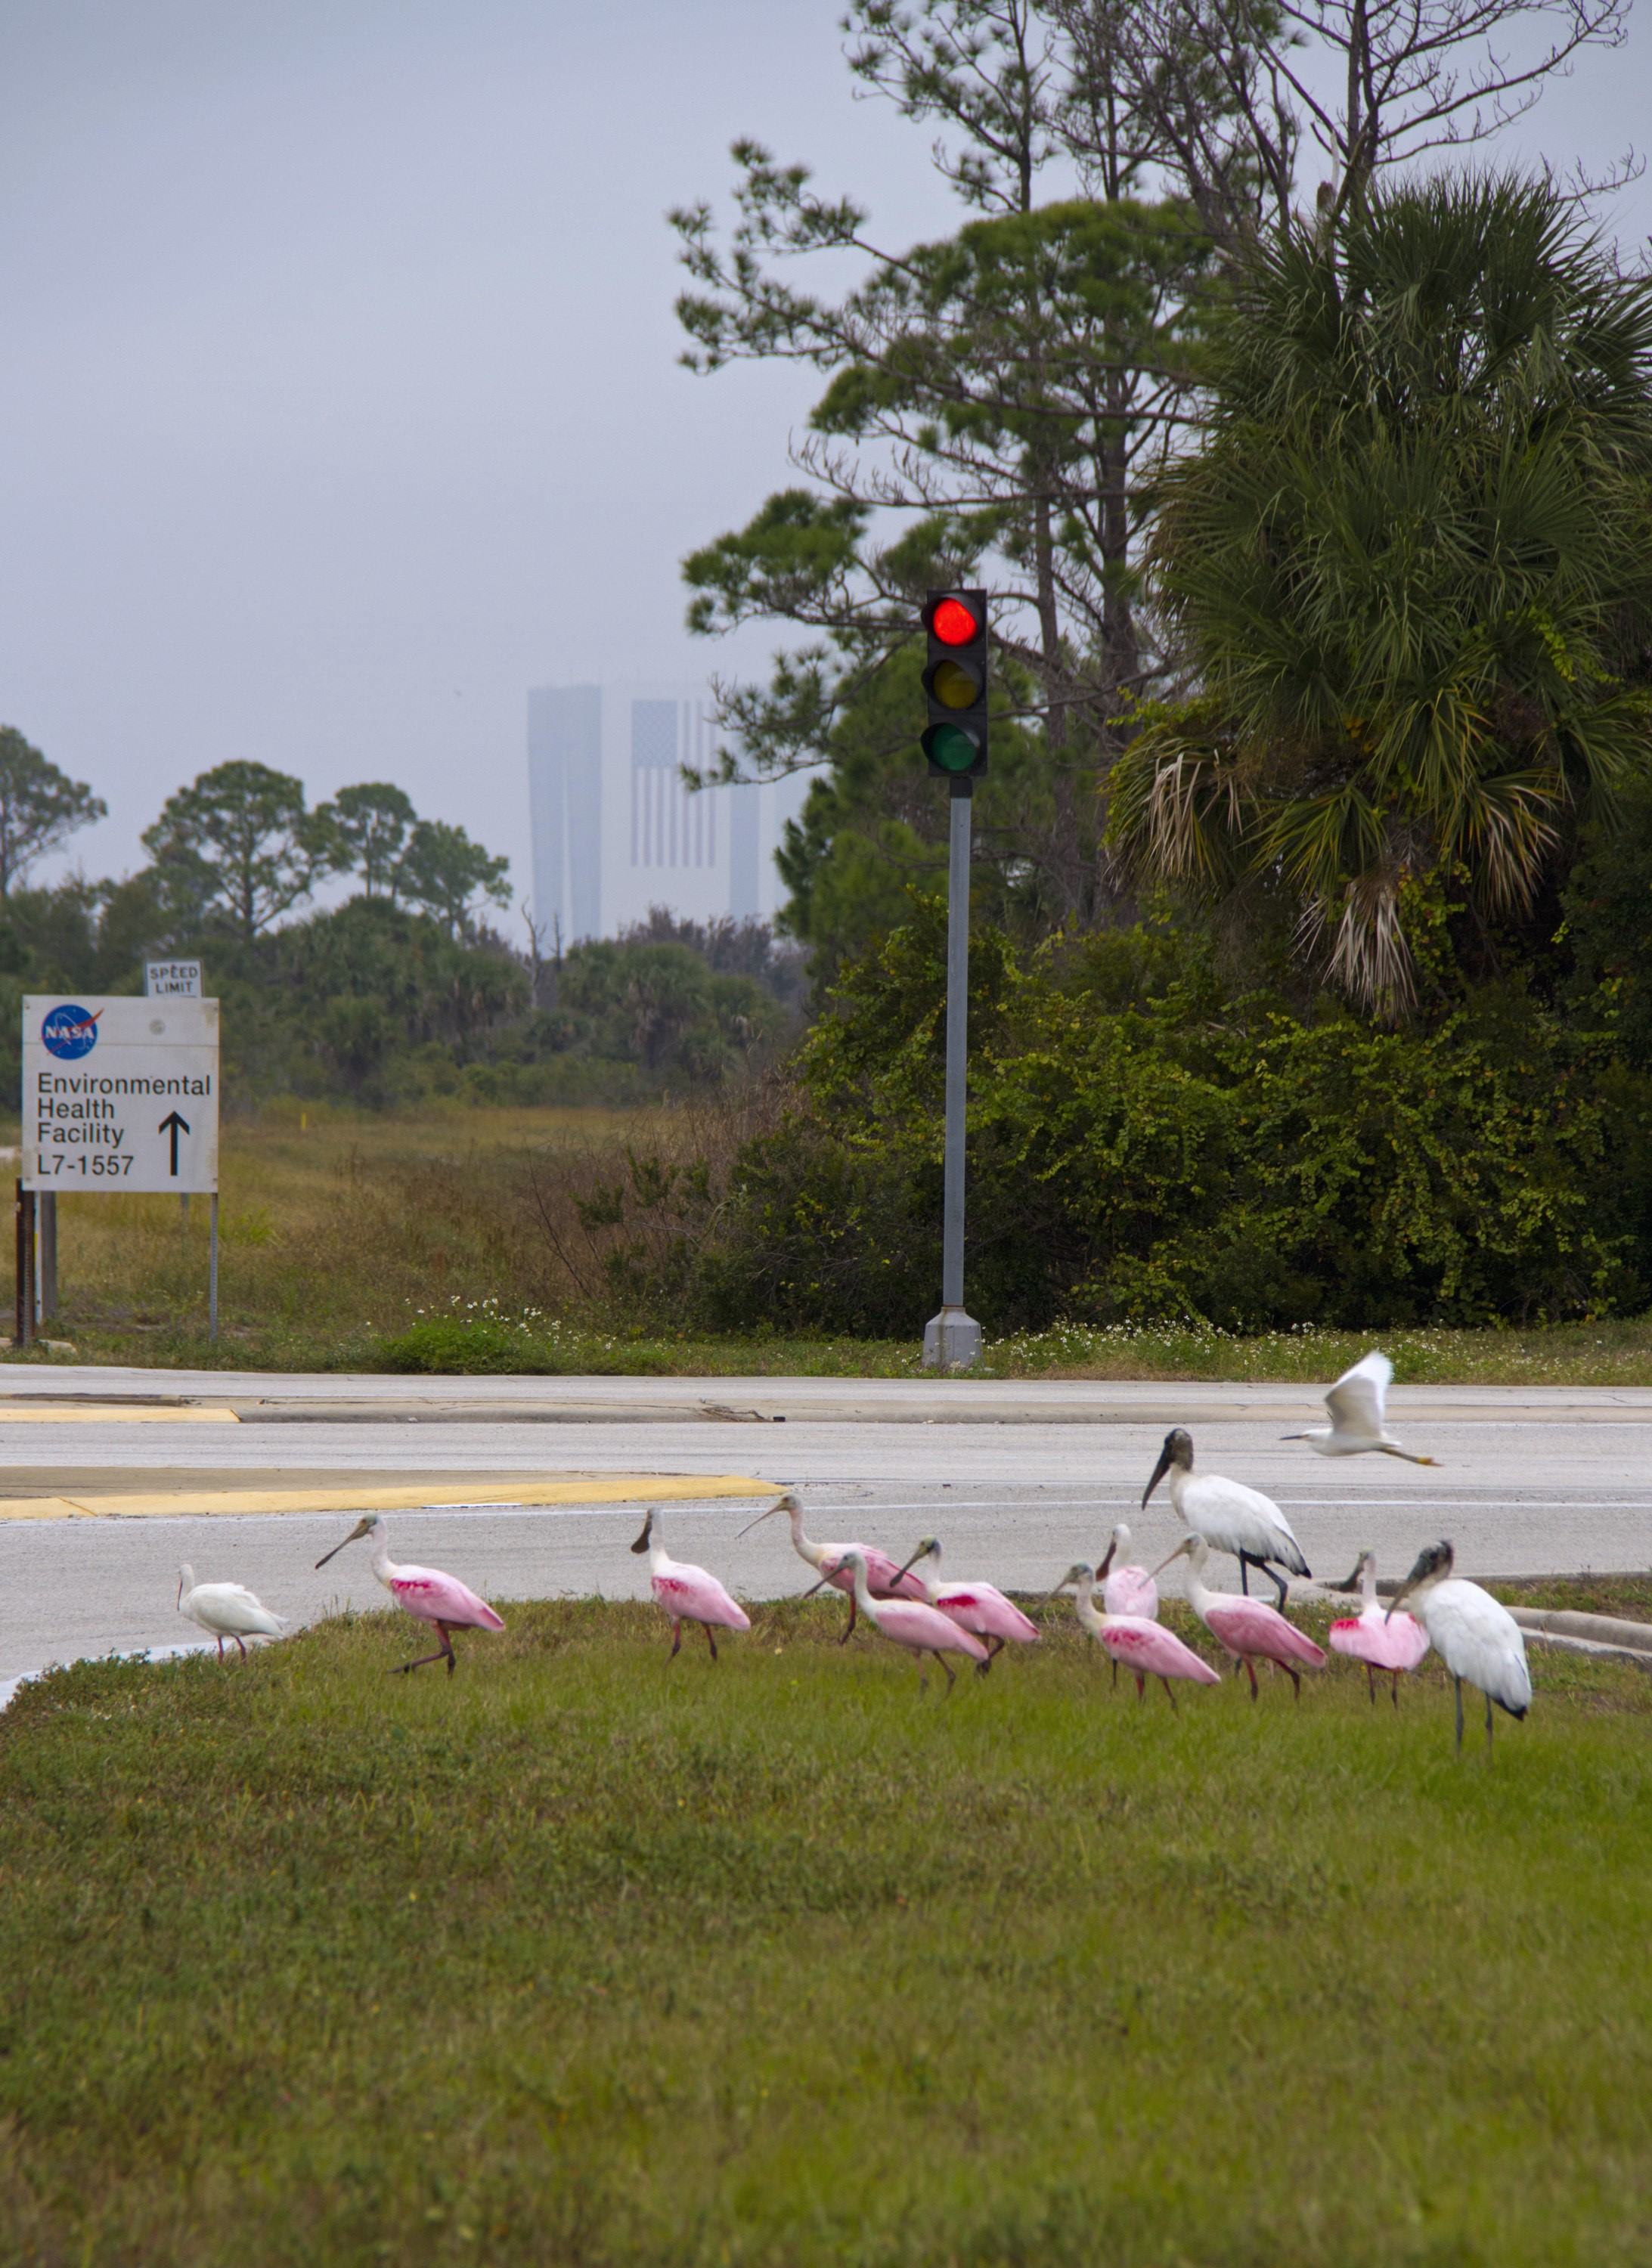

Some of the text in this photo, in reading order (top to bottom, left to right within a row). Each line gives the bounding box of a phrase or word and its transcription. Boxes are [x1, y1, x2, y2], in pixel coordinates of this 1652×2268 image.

[150, 966, 197, 980] SPEED
[156, 981, 192, 993] LIMIT
[45, 1025, 95, 1040] NASA
[38, 1073, 210, 1095] Environmental
[38, 1098, 115, 1119] Health
[38, 1123, 124, 1148] Facility
[38, 1154, 134, 1176] L7-1557
